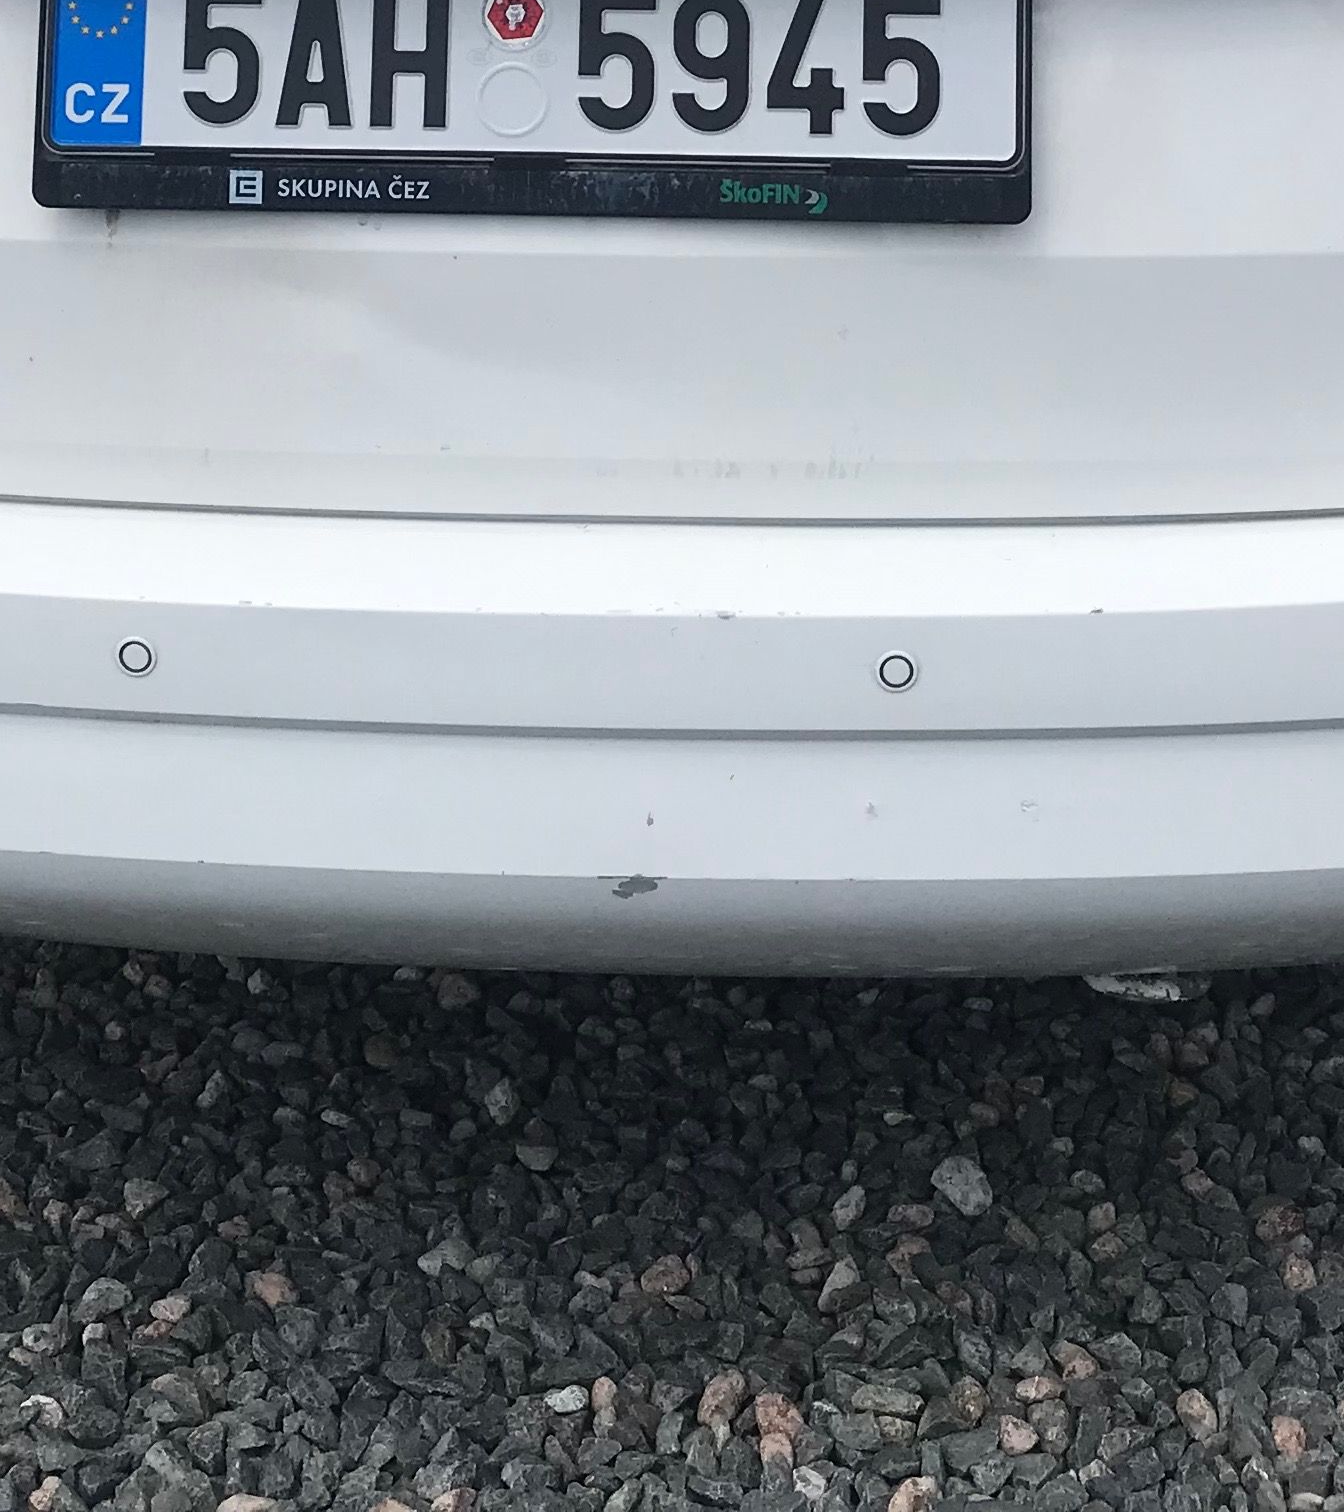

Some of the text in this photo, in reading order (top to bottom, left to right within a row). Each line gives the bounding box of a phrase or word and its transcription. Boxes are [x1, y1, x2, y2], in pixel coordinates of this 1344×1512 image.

[65, 82, 130, 124] CZ
[277, 174, 430, 199] SKUPINA ČEZ
[719, 178, 801, 204] ŠkoFIN
